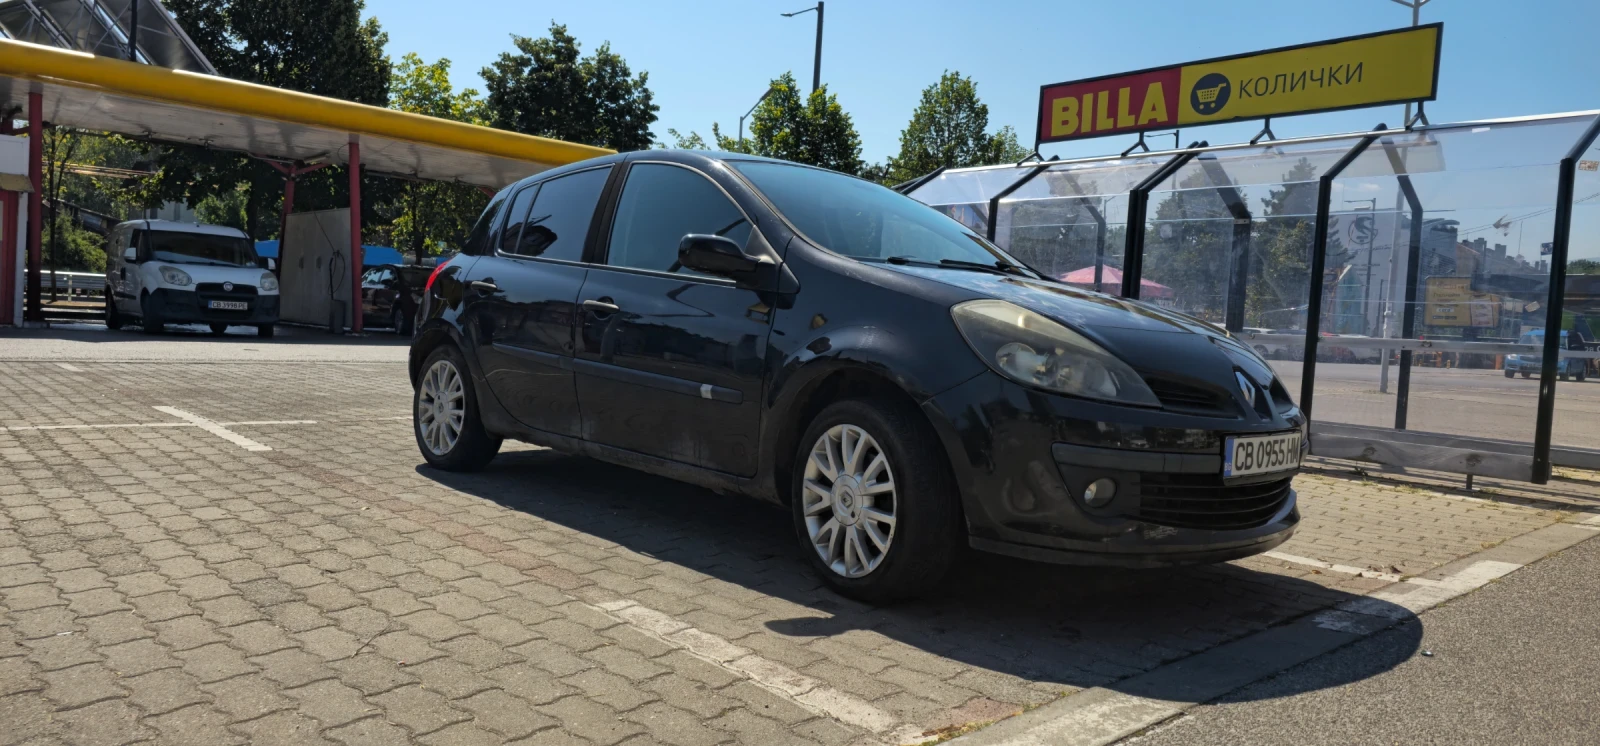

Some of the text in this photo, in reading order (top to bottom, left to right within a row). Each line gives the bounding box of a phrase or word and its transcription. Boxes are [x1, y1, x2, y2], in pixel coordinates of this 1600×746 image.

[1239, 62, 1363, 98] КОЛИЧКИ
[1052, 82, 1167, 136] BILLA
[1234, 436, 1300, 471] CB 0955 HM
